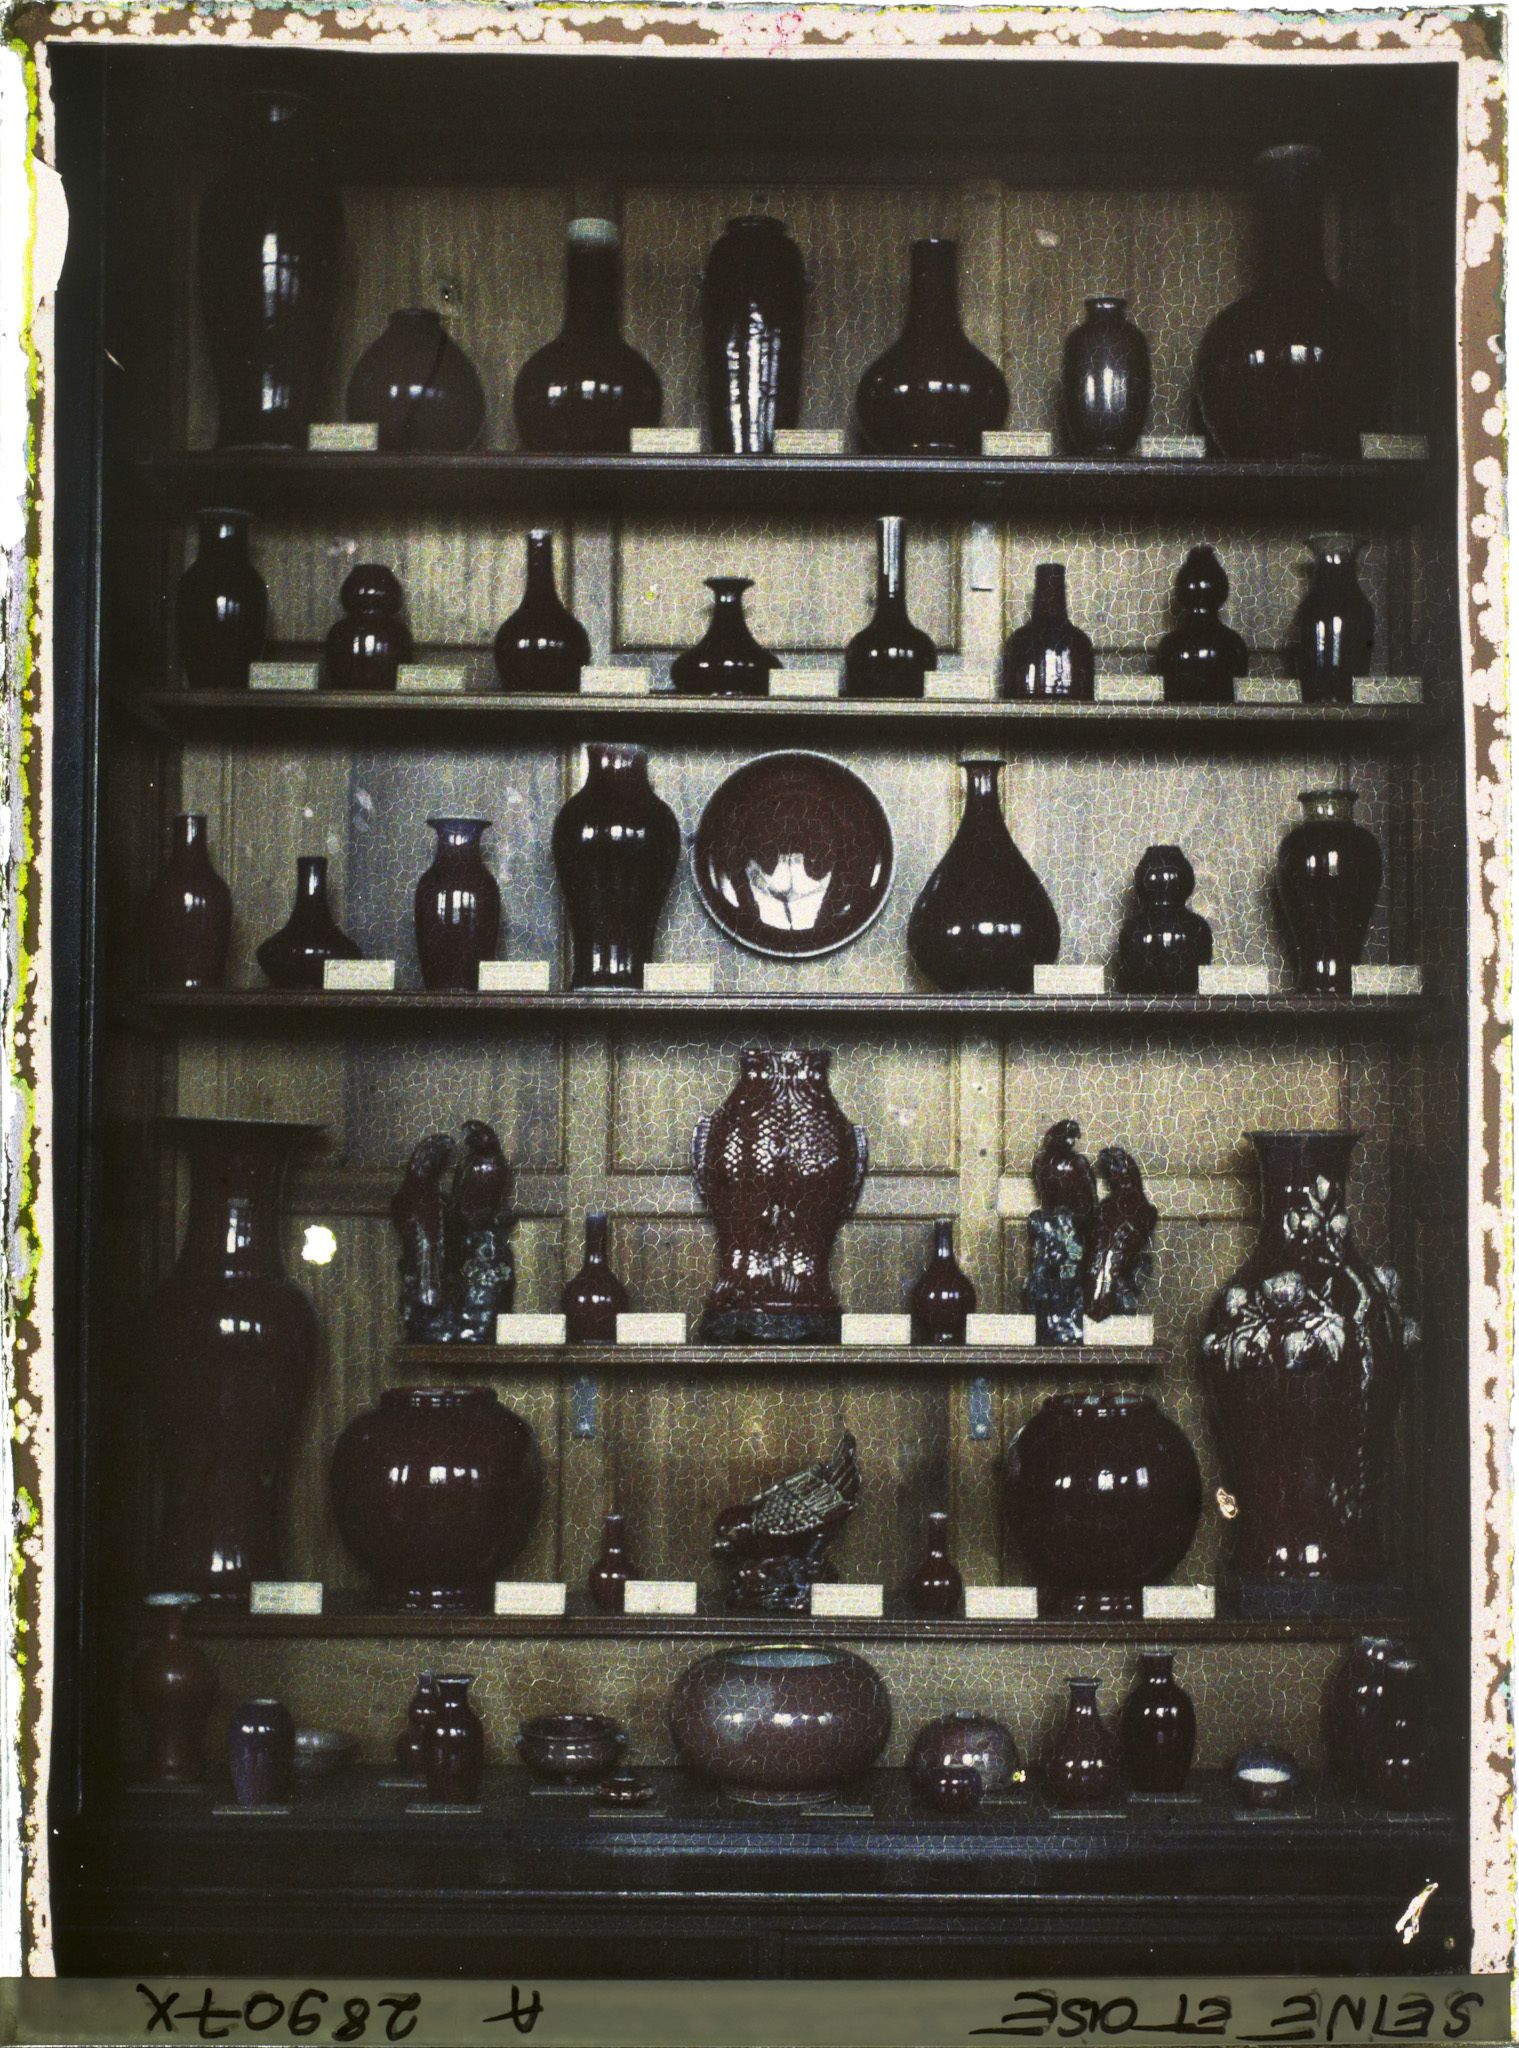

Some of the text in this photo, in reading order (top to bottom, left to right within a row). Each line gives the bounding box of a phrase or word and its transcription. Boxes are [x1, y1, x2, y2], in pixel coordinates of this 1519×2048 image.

[483, 1985, 544, 2034] A
[969, 1991, 1484, 2041] SEINE ET OISE
